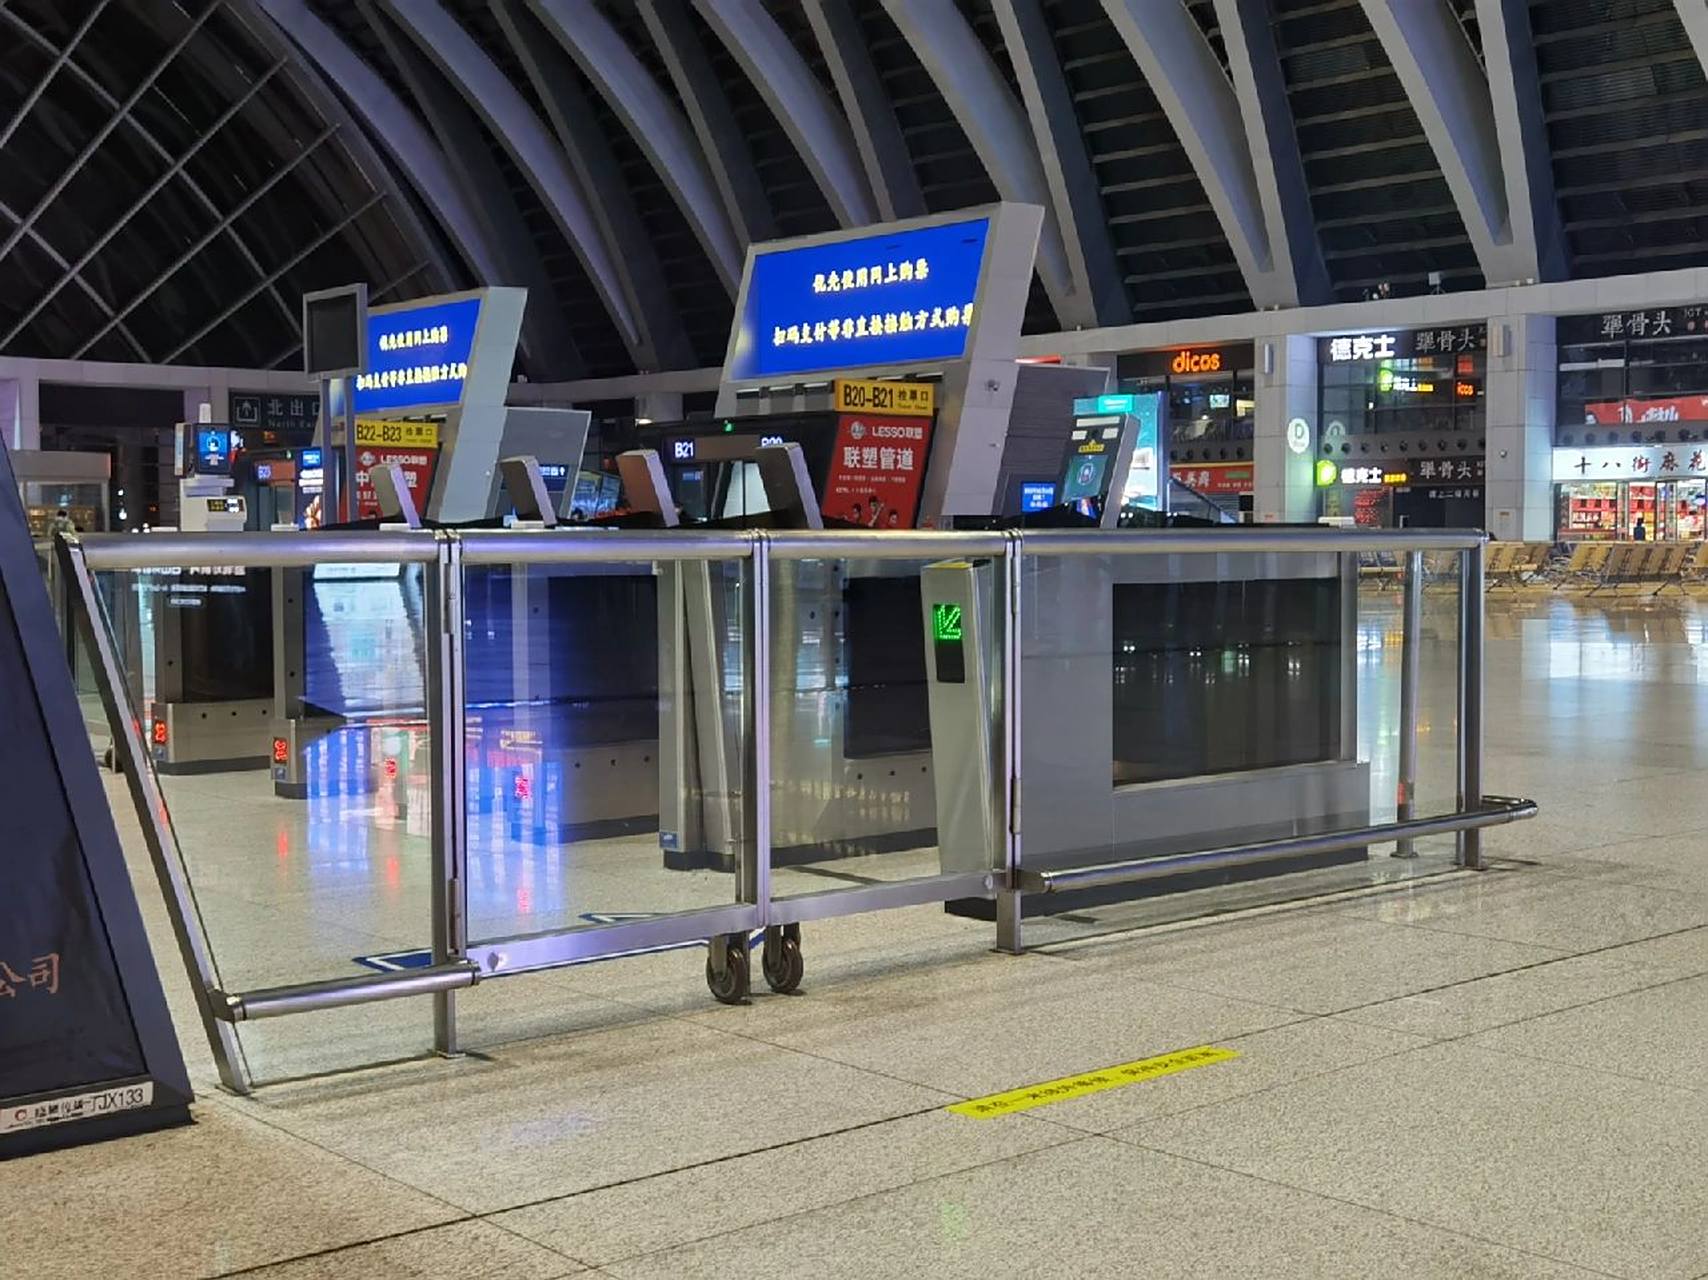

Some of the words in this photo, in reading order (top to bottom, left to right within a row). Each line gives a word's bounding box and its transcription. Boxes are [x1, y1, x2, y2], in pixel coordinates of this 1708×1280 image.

[1330, 334, 1396, 362] 德克士
[1172, 350, 1221, 373] dicos
[843, 384, 894, 408] B20-B21
[356, 424, 402, 442] B22-B23
[674, 441, 694, 459] B21
[843, 446, 914, 471] 联塑管道
[1574, 449, 1706, 475] 十八街麻花
